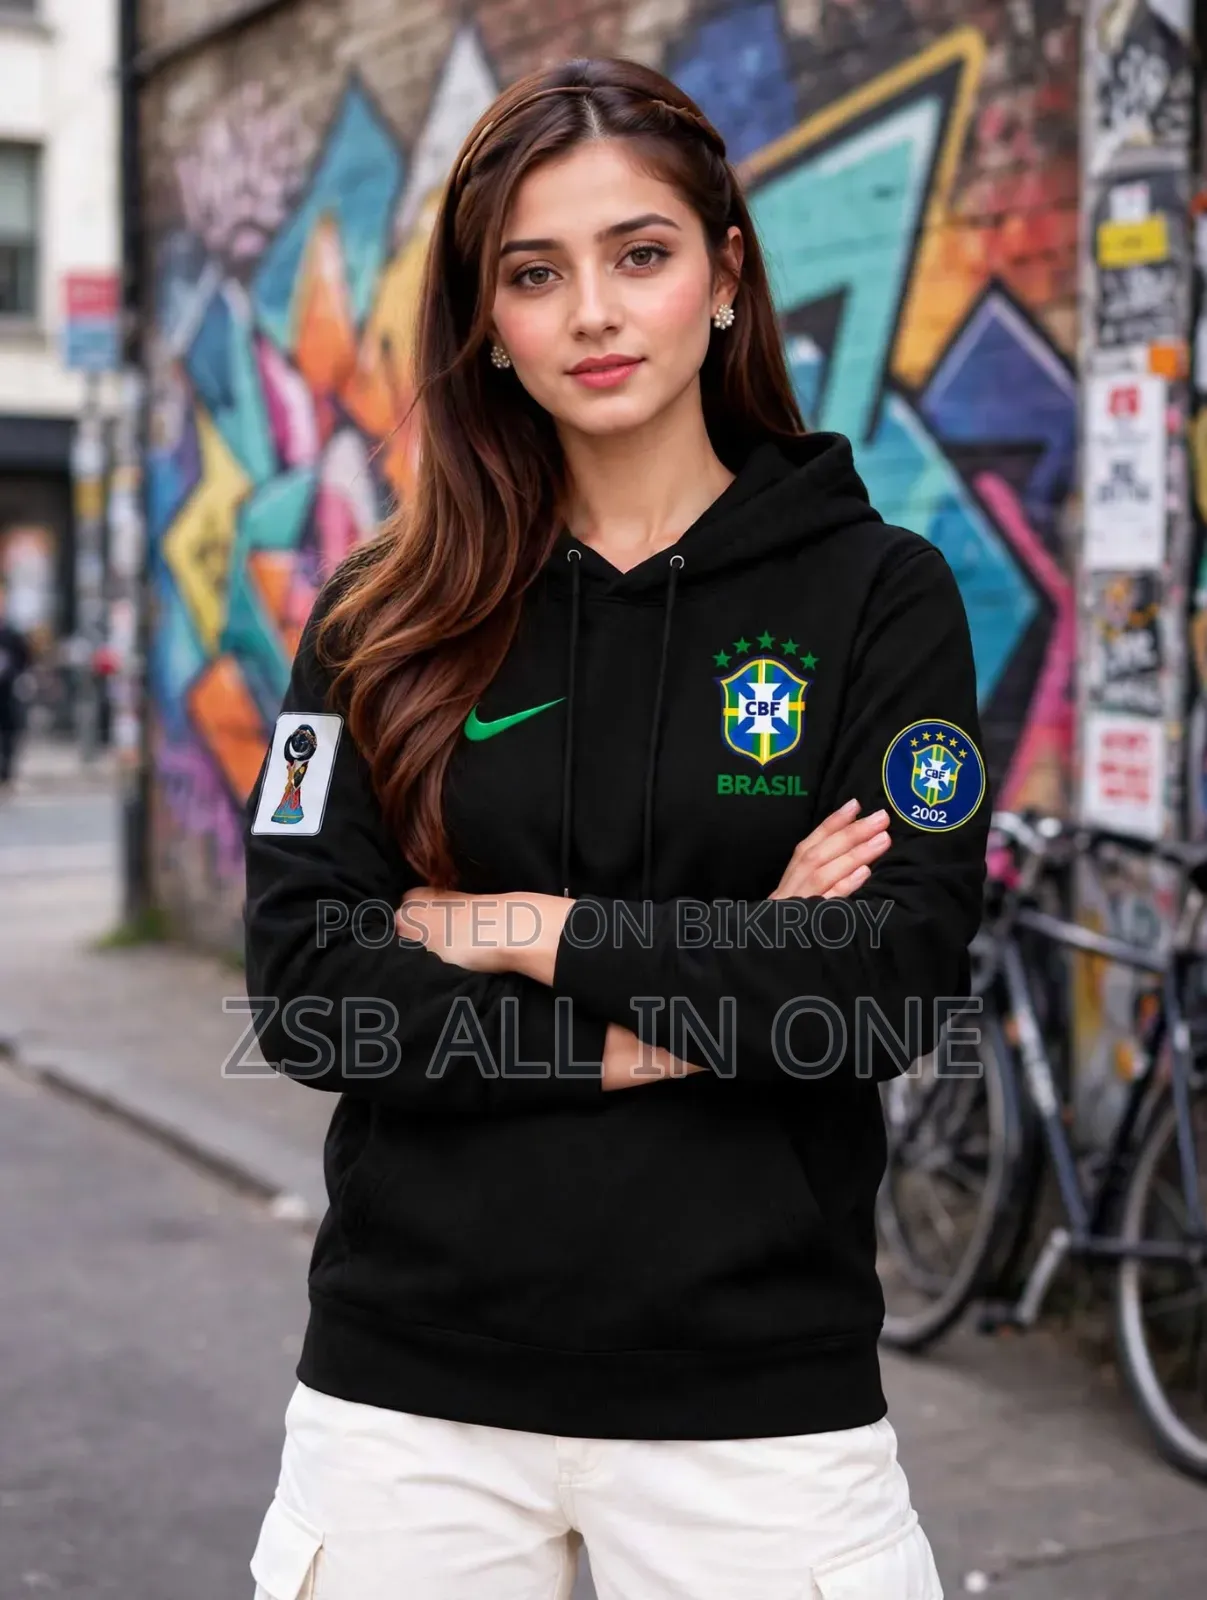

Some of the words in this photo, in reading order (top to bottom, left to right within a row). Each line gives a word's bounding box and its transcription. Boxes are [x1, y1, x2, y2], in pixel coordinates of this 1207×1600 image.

[745, 701, 781, 716] CBF
[924, 768, 946, 780] CBF
[717, 774, 808, 796] BRASIL
[910, 805, 947, 824] 2002
